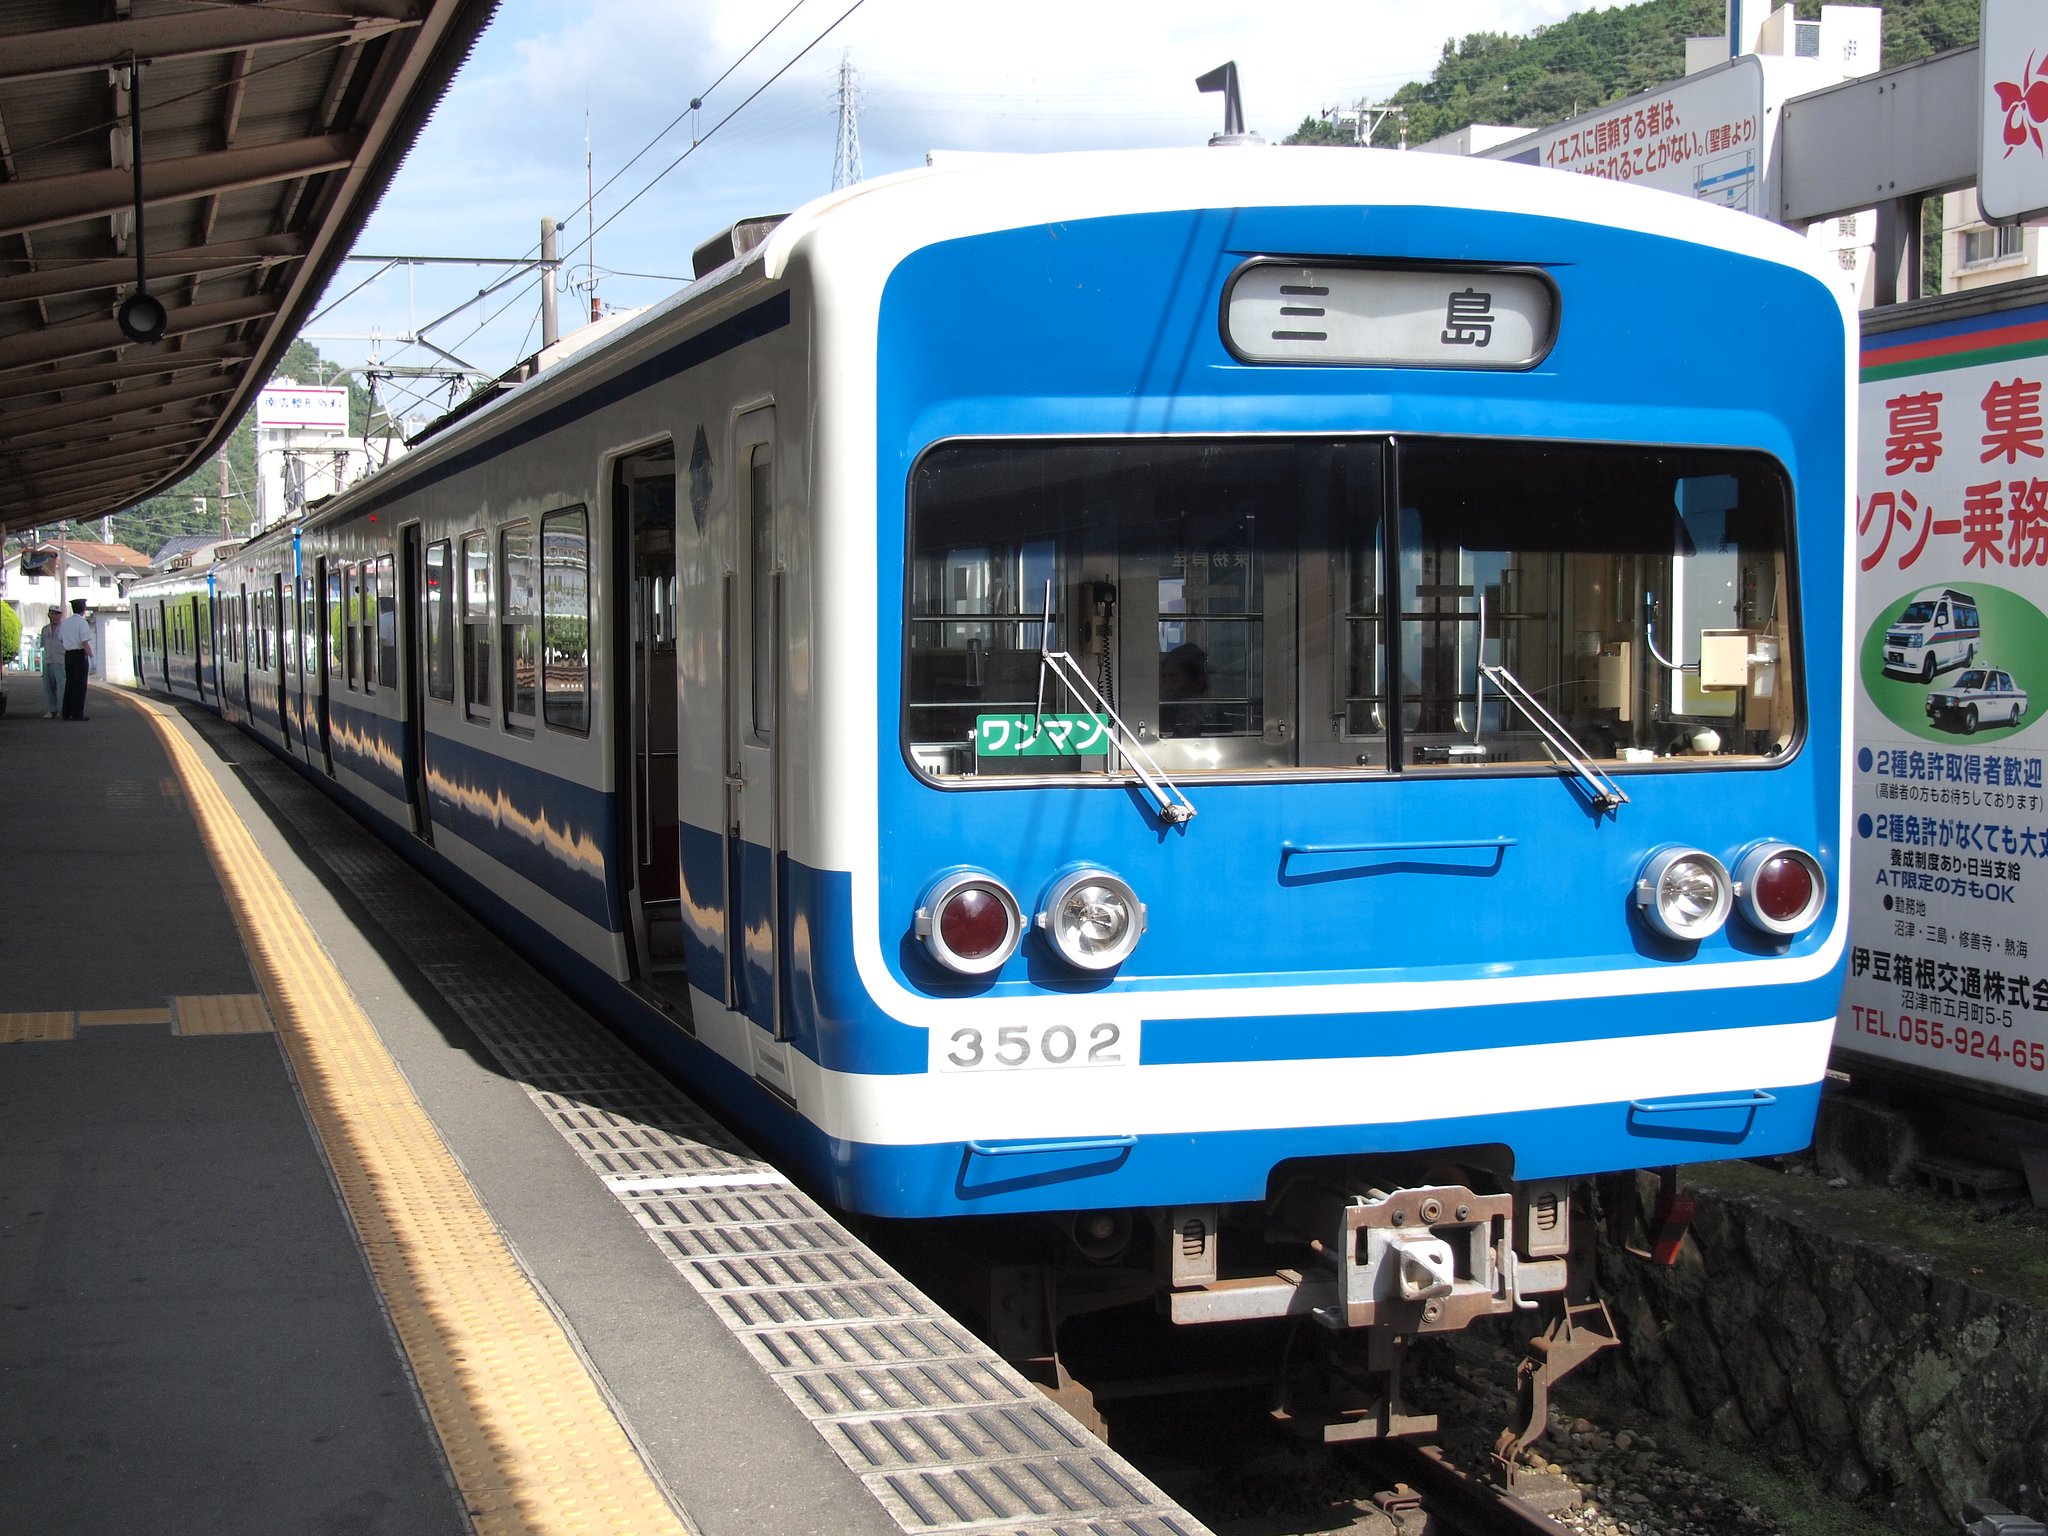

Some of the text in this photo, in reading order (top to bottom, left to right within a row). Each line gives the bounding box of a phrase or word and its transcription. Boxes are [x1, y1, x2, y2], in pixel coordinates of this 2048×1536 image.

[1546, 99, 1681, 169] イエスに信頼する者は、
[1271, 285, 1496, 348] 三島
[1885, 377, 2045, 477] 募集
[1856, 476, 2048, 572] クシー乗務
[982, 720, 1104, 750] ワンマン
[1876, 749, 2042, 789] 2種免許取得者歓迎
[1876, 868, 2015, 904] AT限定の方もOK
[947, 1022, 1121, 1067] 3502
